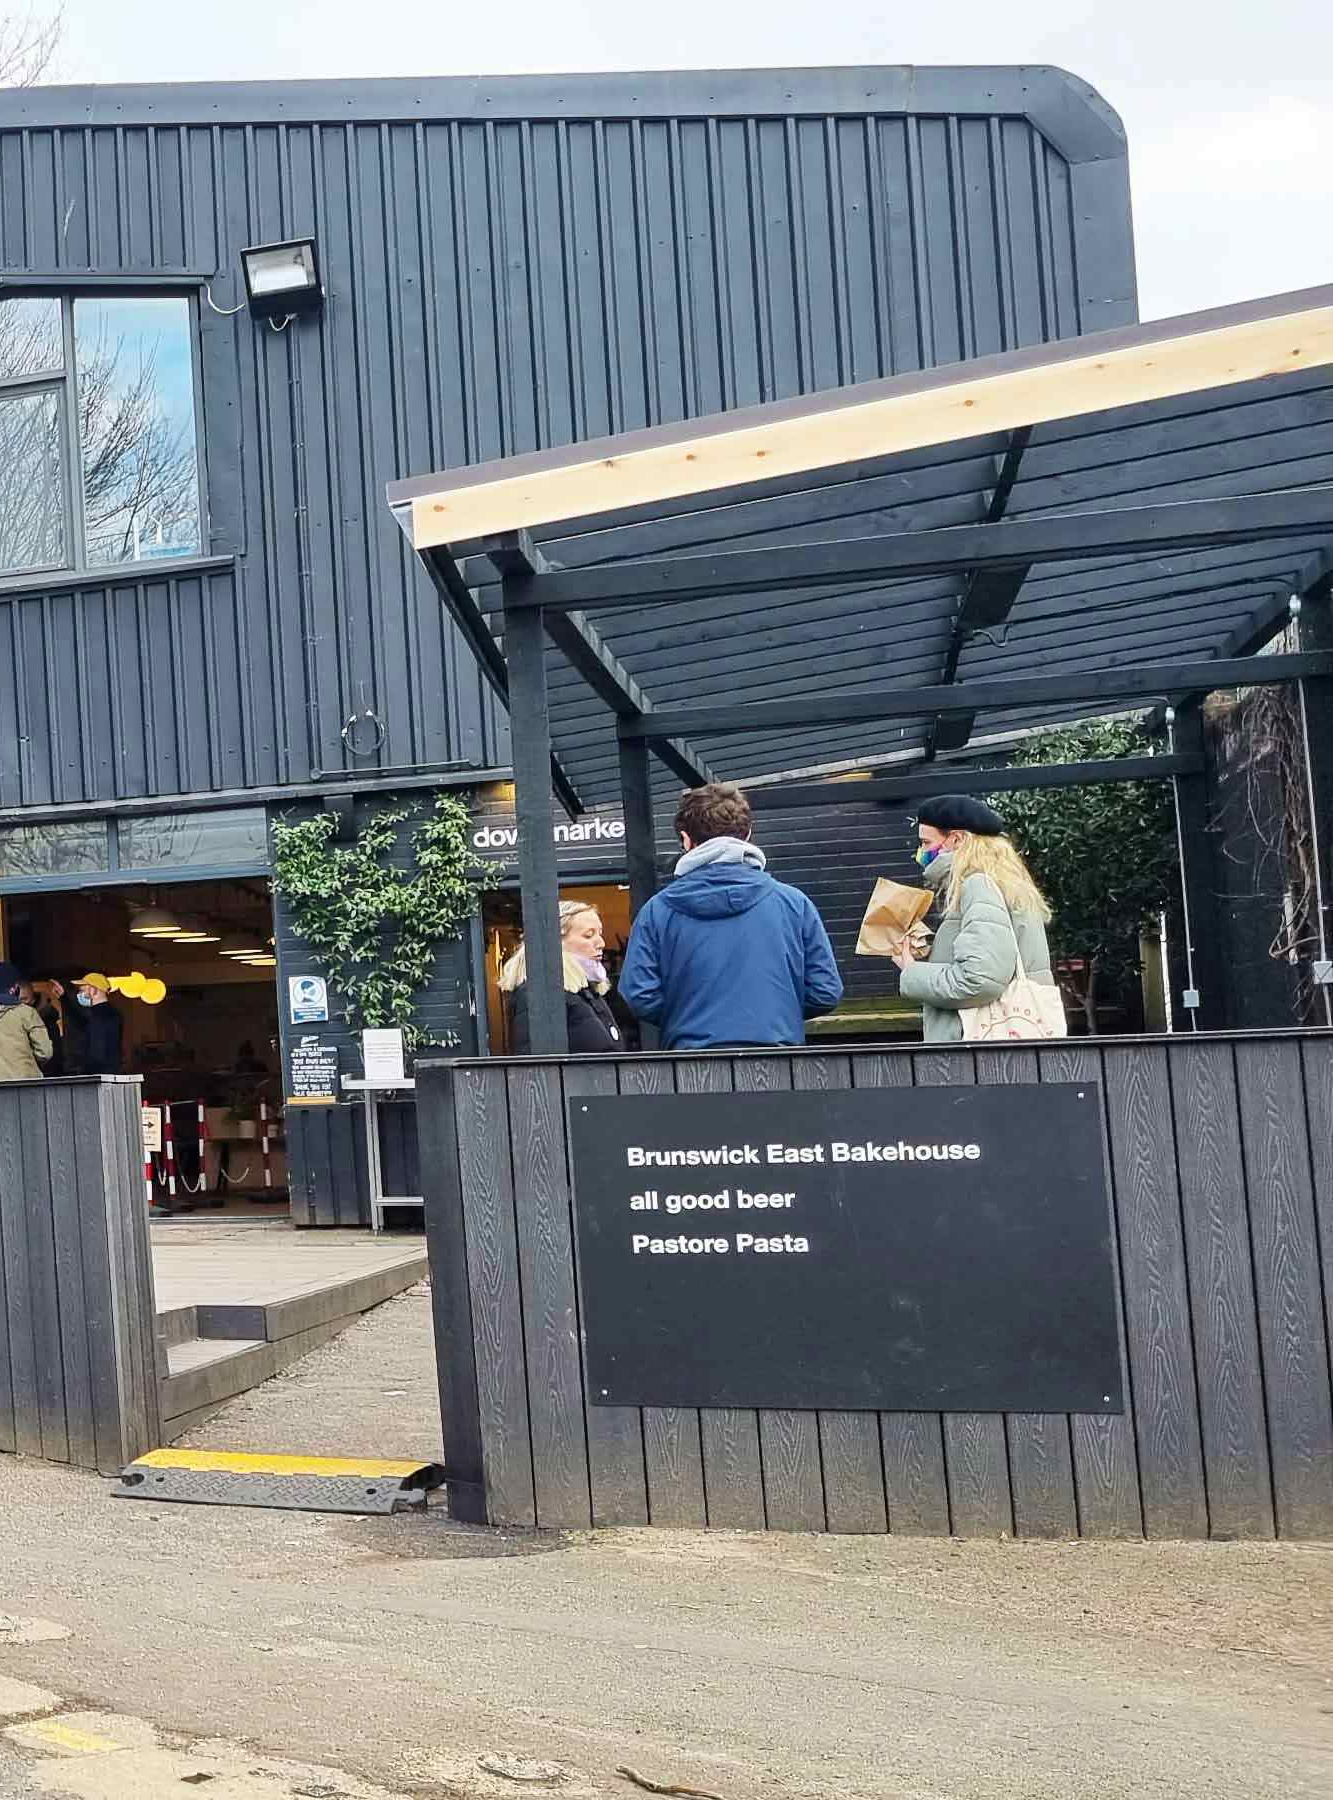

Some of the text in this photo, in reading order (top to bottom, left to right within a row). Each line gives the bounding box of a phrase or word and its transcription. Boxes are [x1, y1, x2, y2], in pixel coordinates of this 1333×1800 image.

[627, 1141, 981, 1167] Brunswick East Bakehouse
[630, 1189, 796, 1214] all good beer
[632, 1233, 809, 1254] Pastore Pasta
